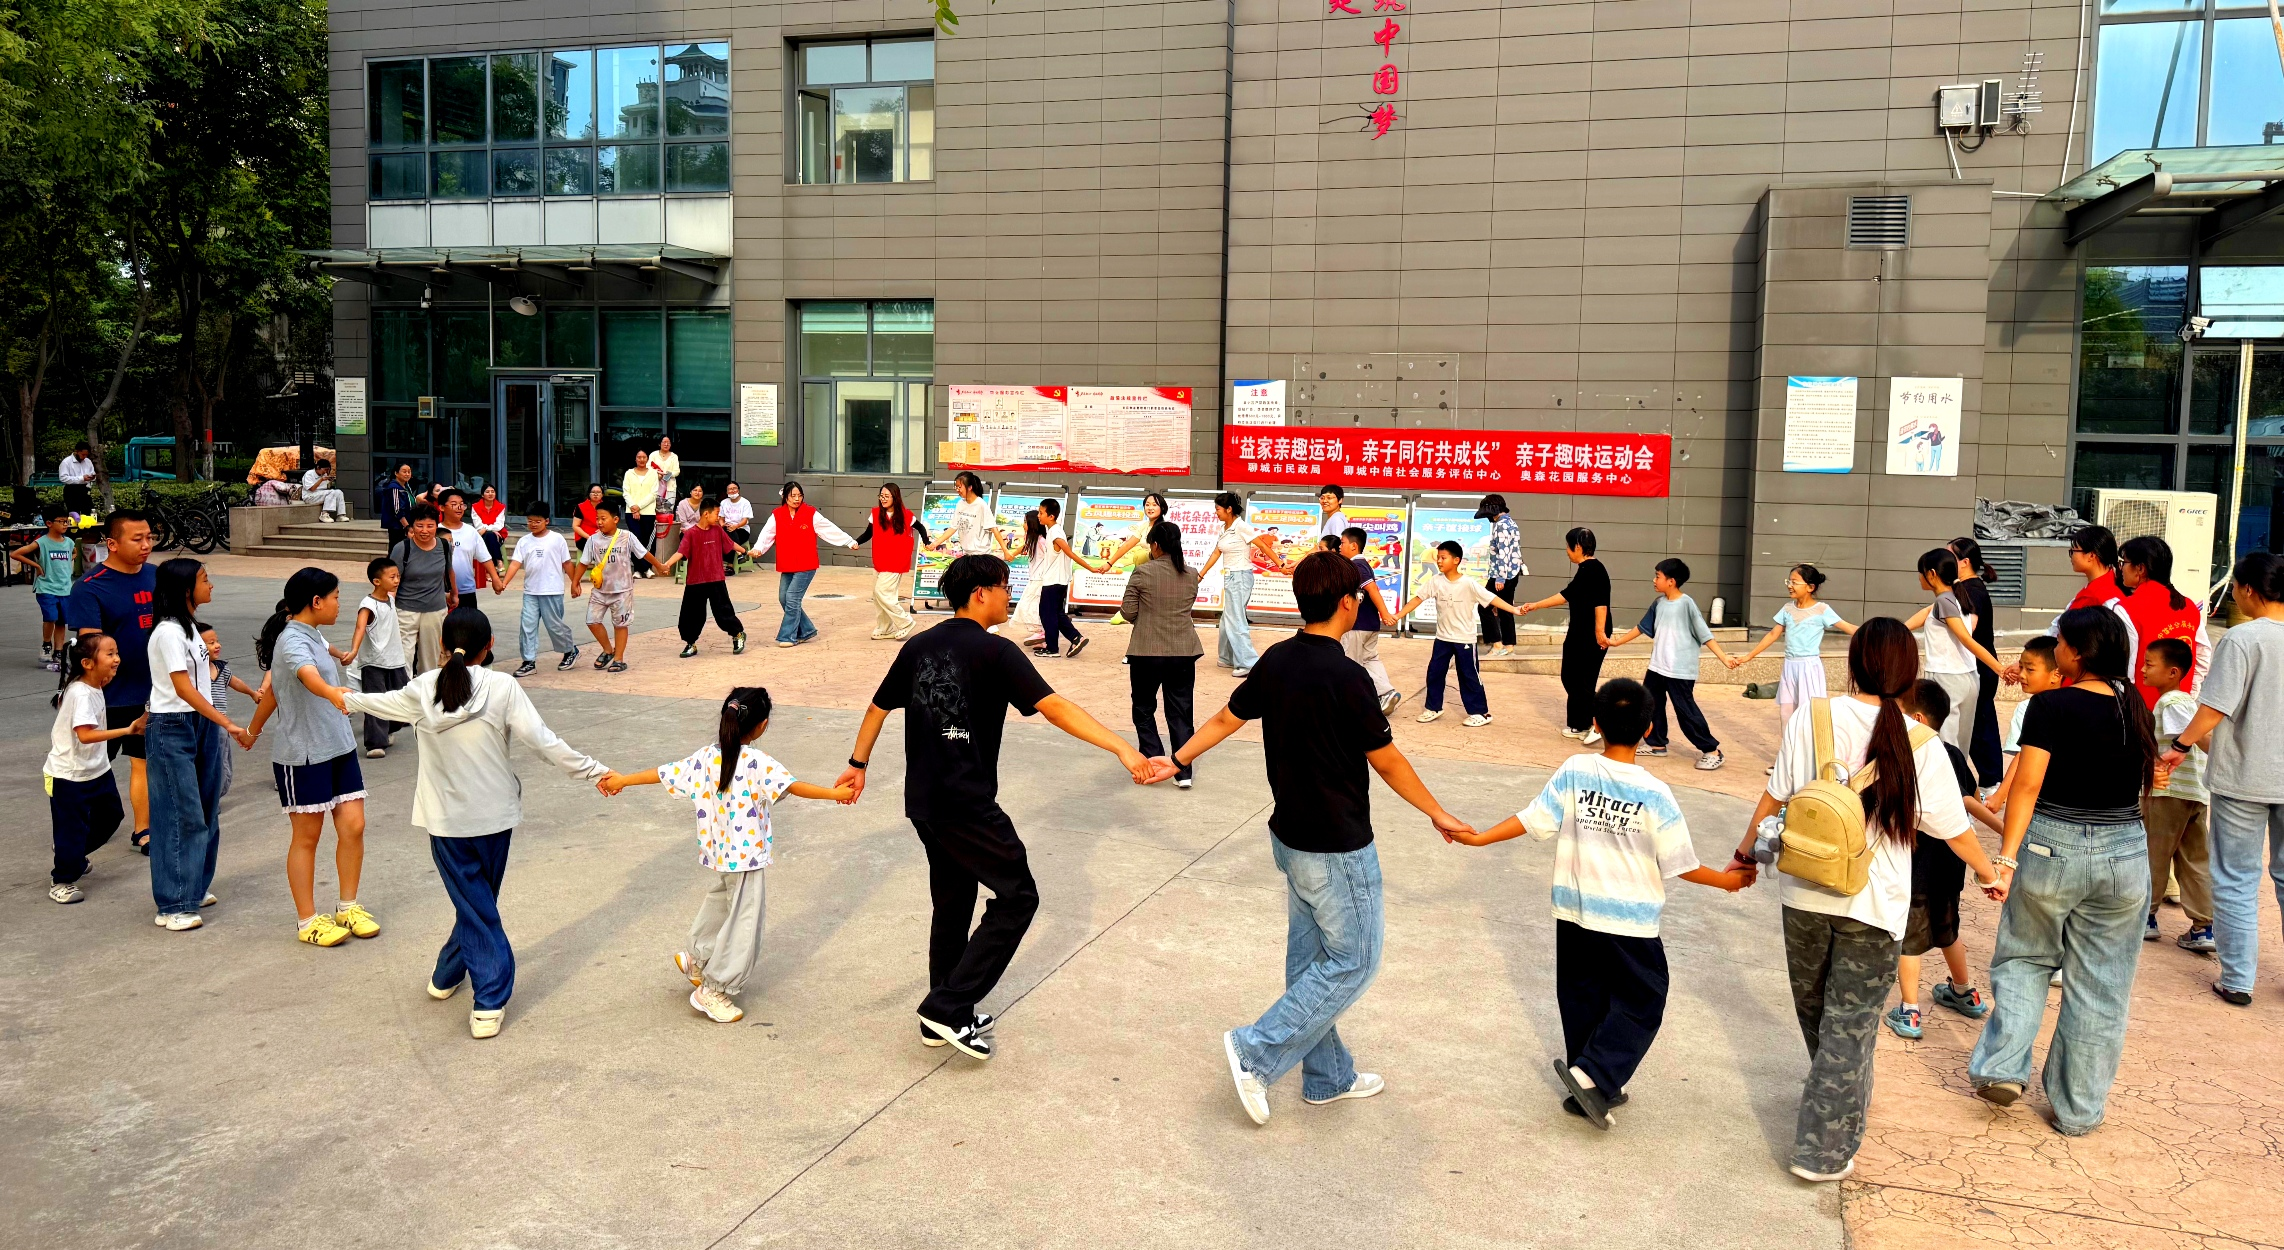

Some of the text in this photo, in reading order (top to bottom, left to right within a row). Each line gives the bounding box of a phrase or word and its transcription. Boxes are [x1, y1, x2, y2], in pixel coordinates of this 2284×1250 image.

[1251, 388, 1268, 397] 注意
[1900, 391, 1953, 404] 节约用水
[1515, 442, 1654, 470] 亲子趣味运动会
[1248, 462, 1632, 484] 聊城市民政局 聊城中信社会服务评估中心 奥森花园服务中心
[1585, 807, 1630, 827] Story
